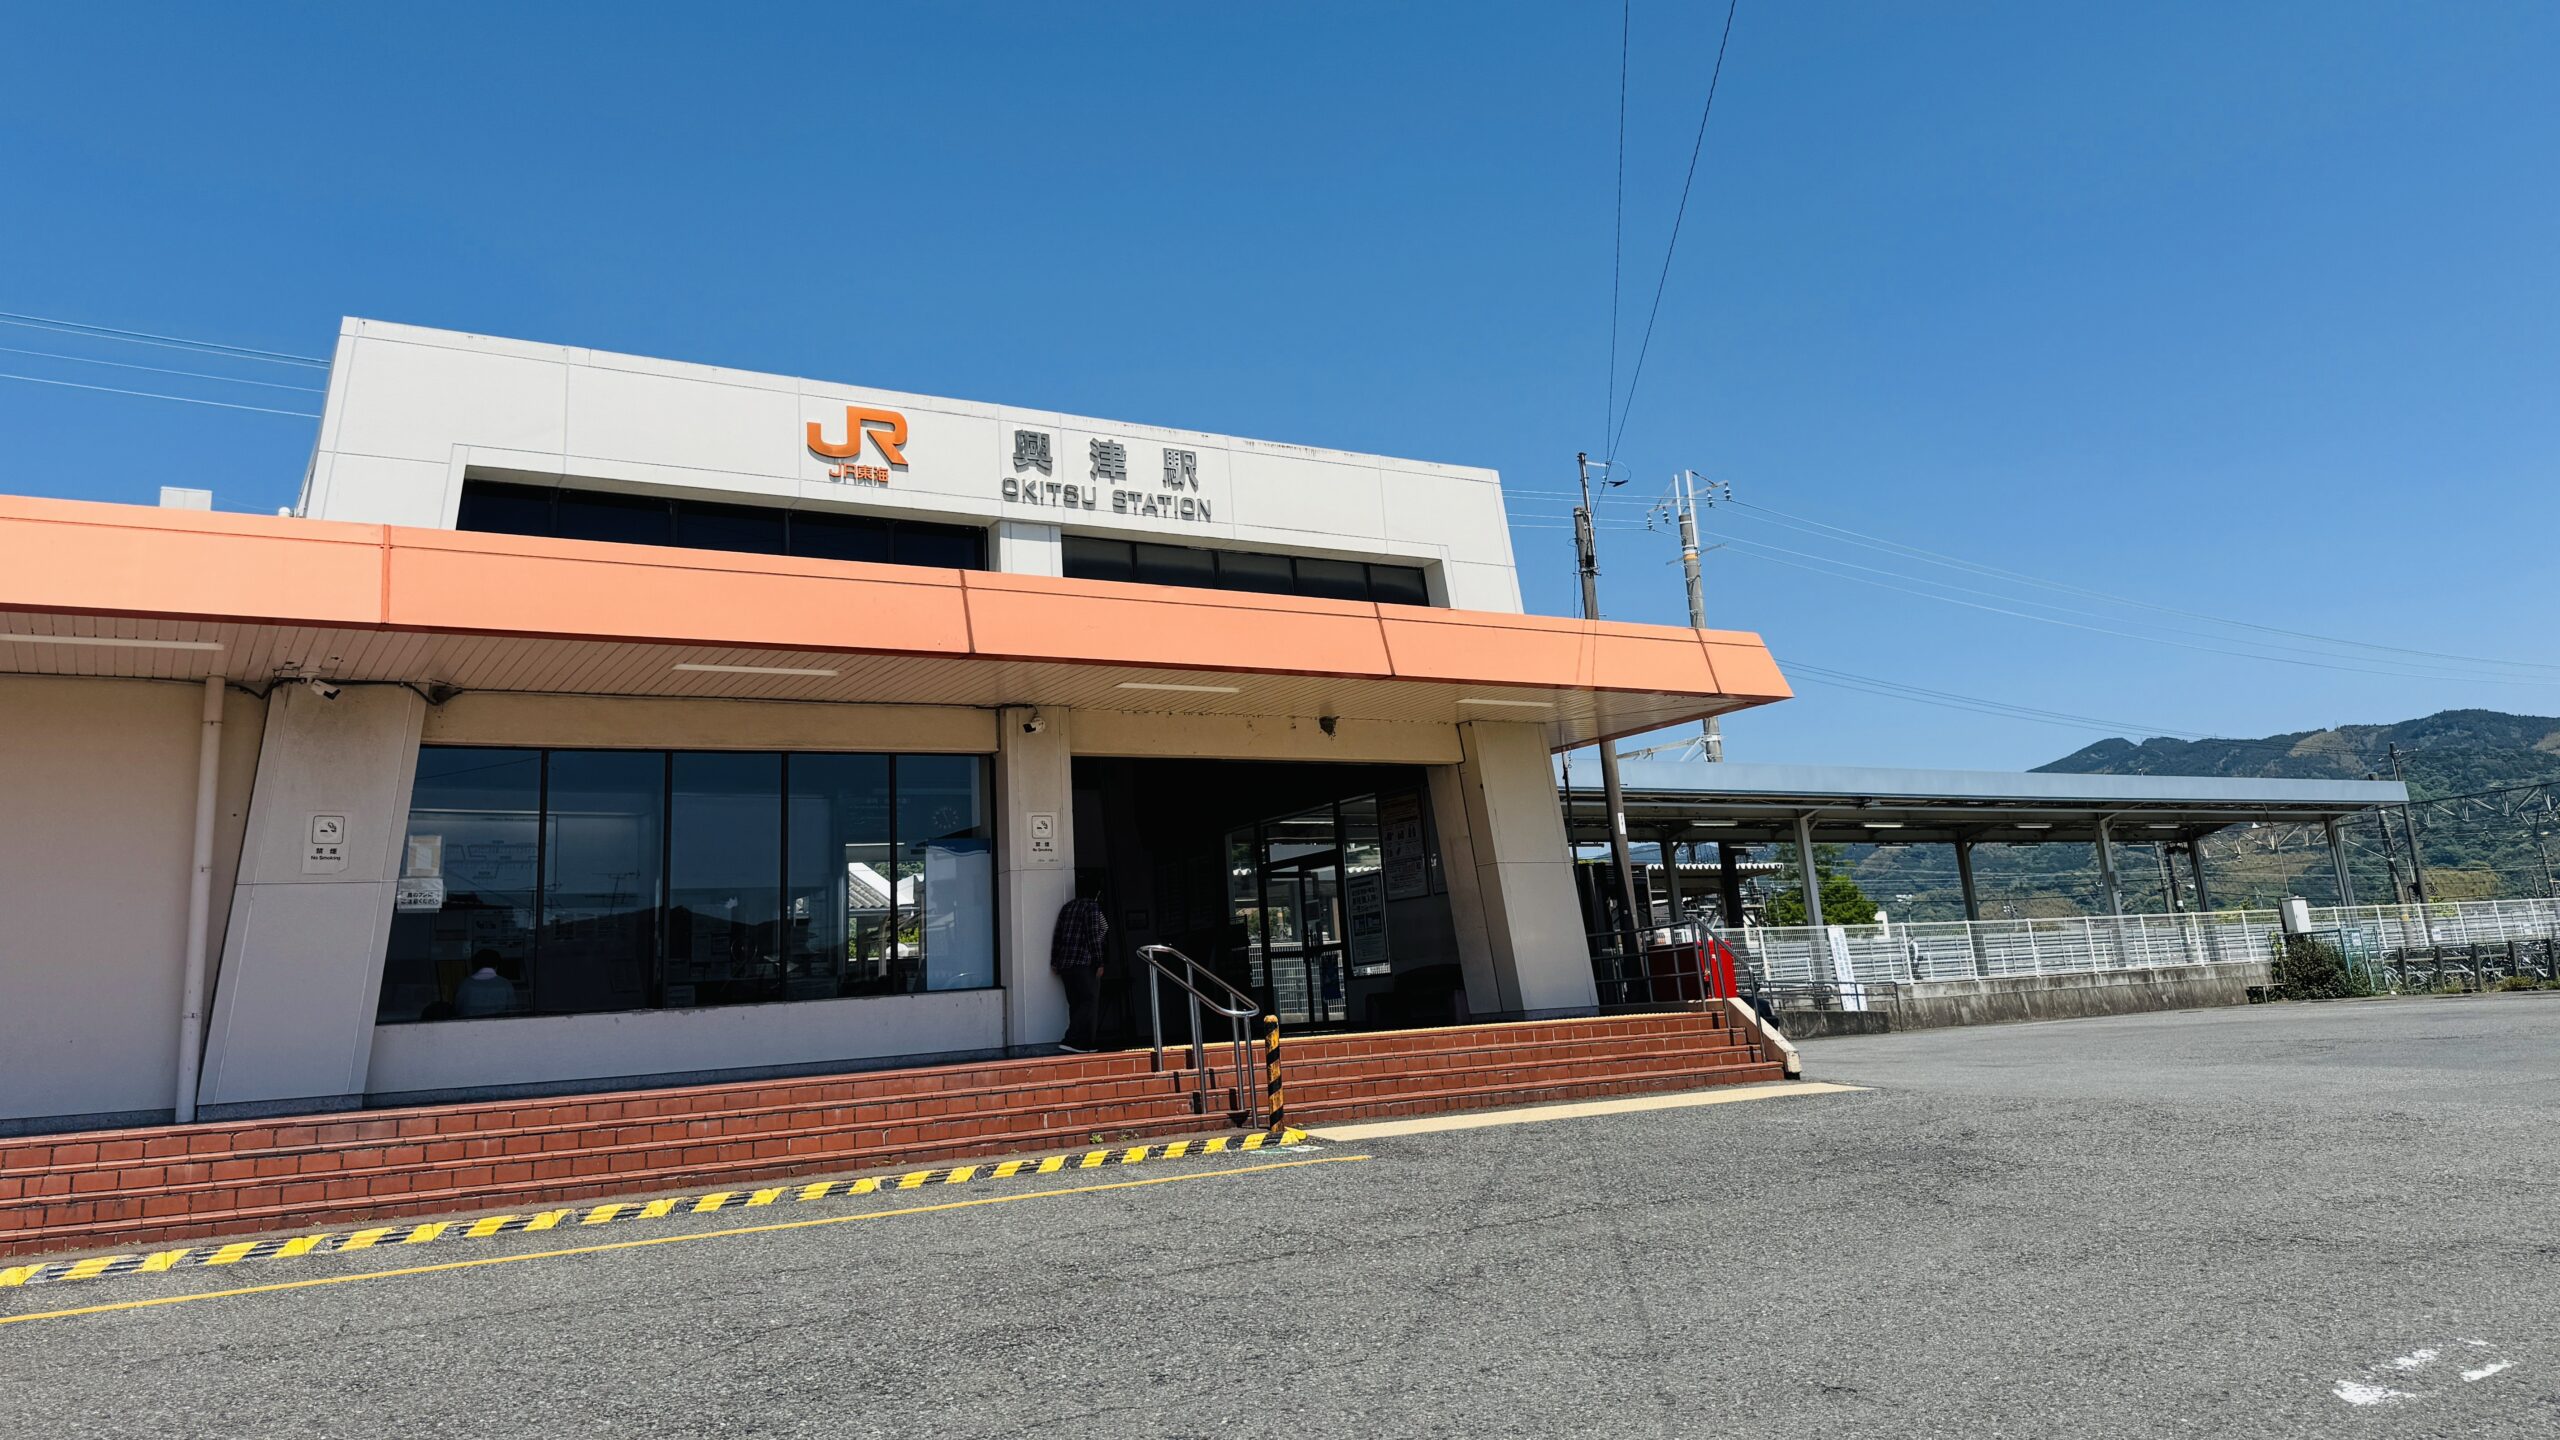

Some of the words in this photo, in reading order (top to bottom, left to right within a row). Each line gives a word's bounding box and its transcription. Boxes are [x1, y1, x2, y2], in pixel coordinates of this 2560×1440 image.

[806, 405, 908, 466] JR
[1013, 430, 1200, 490] 興津駅
[829, 463, 889, 483] JR東海
[1001, 477, 1097, 509] OKITSU
[1112, 489, 1211, 521] STATION
